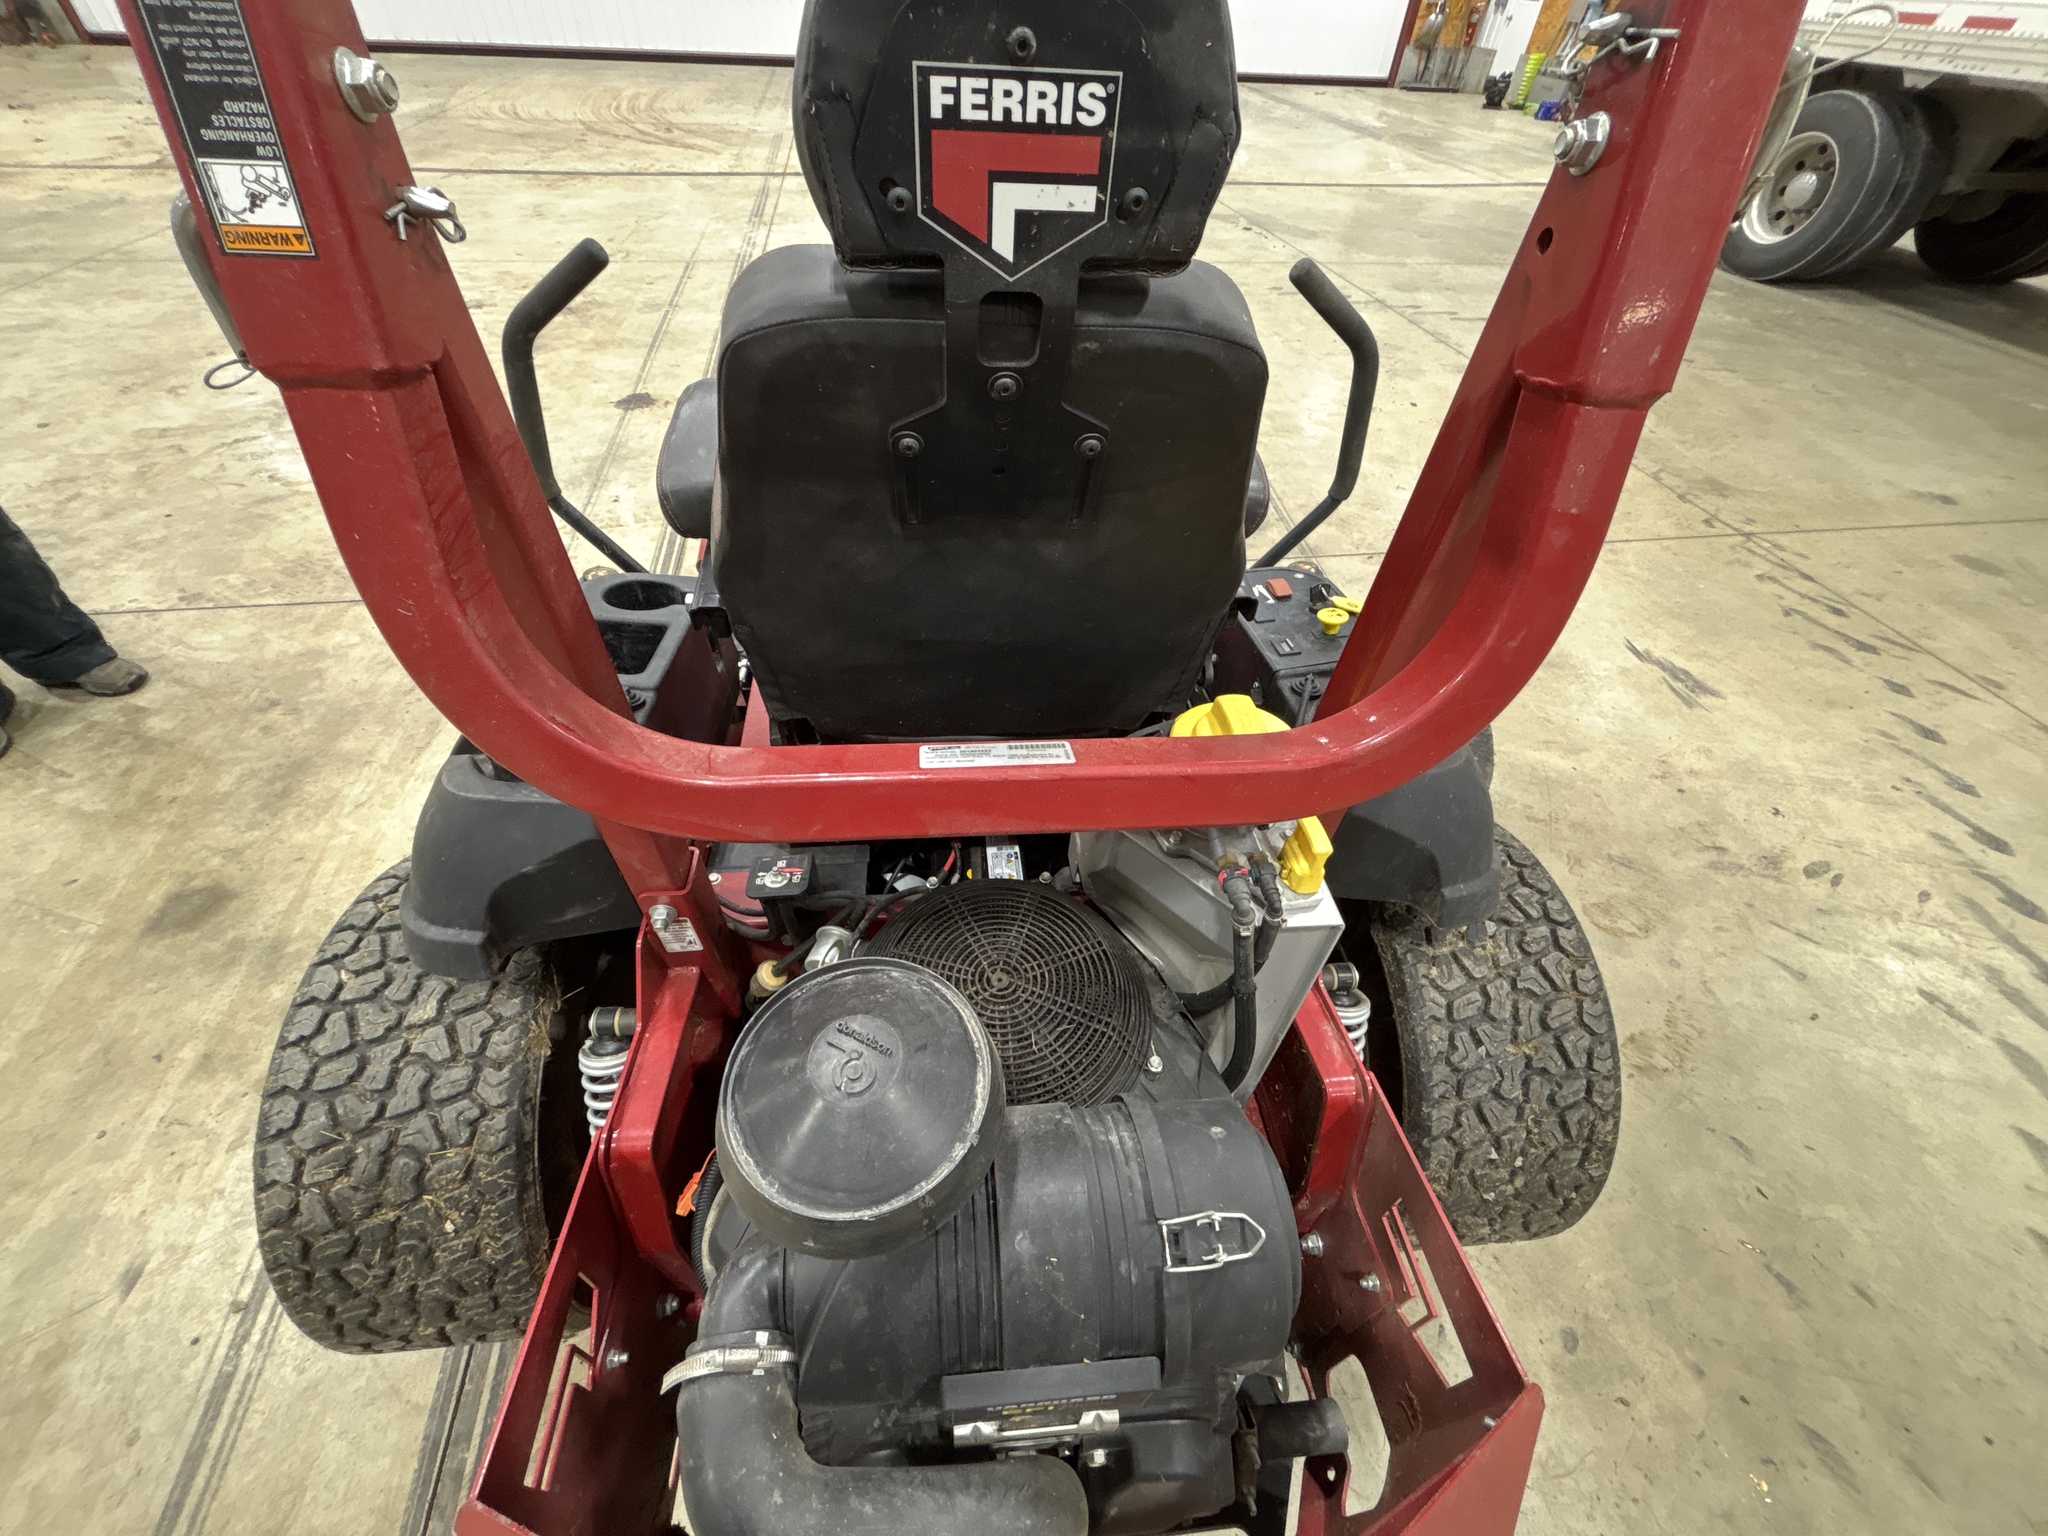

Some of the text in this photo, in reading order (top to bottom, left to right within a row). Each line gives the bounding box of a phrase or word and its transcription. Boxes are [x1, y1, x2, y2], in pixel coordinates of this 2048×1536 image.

[188, 11, 238, 22] overhanging
[204, 25, 214, 34] to
[182, 38, 200, 46] NOT
[200, 38, 212, 47] Do
[199, 50, 221, 59] under
[222, 50, 250, 60] driving
[186, 62, 211, 71] before
[183, 74, 219, 83] overhead
[221, 76, 232, 84] for
[929, 75, 1107, 127] FERRIS
[223, 100, 266, 114] HAZARD
[211, 115, 270, 128] OBSTACLES
[200, 129, 275, 143] OVERHANGING
[256, 146, 279, 157] LOW
[224, 231, 293, 246] WARNING
[836, 1021, 893, 1059] donaldson
